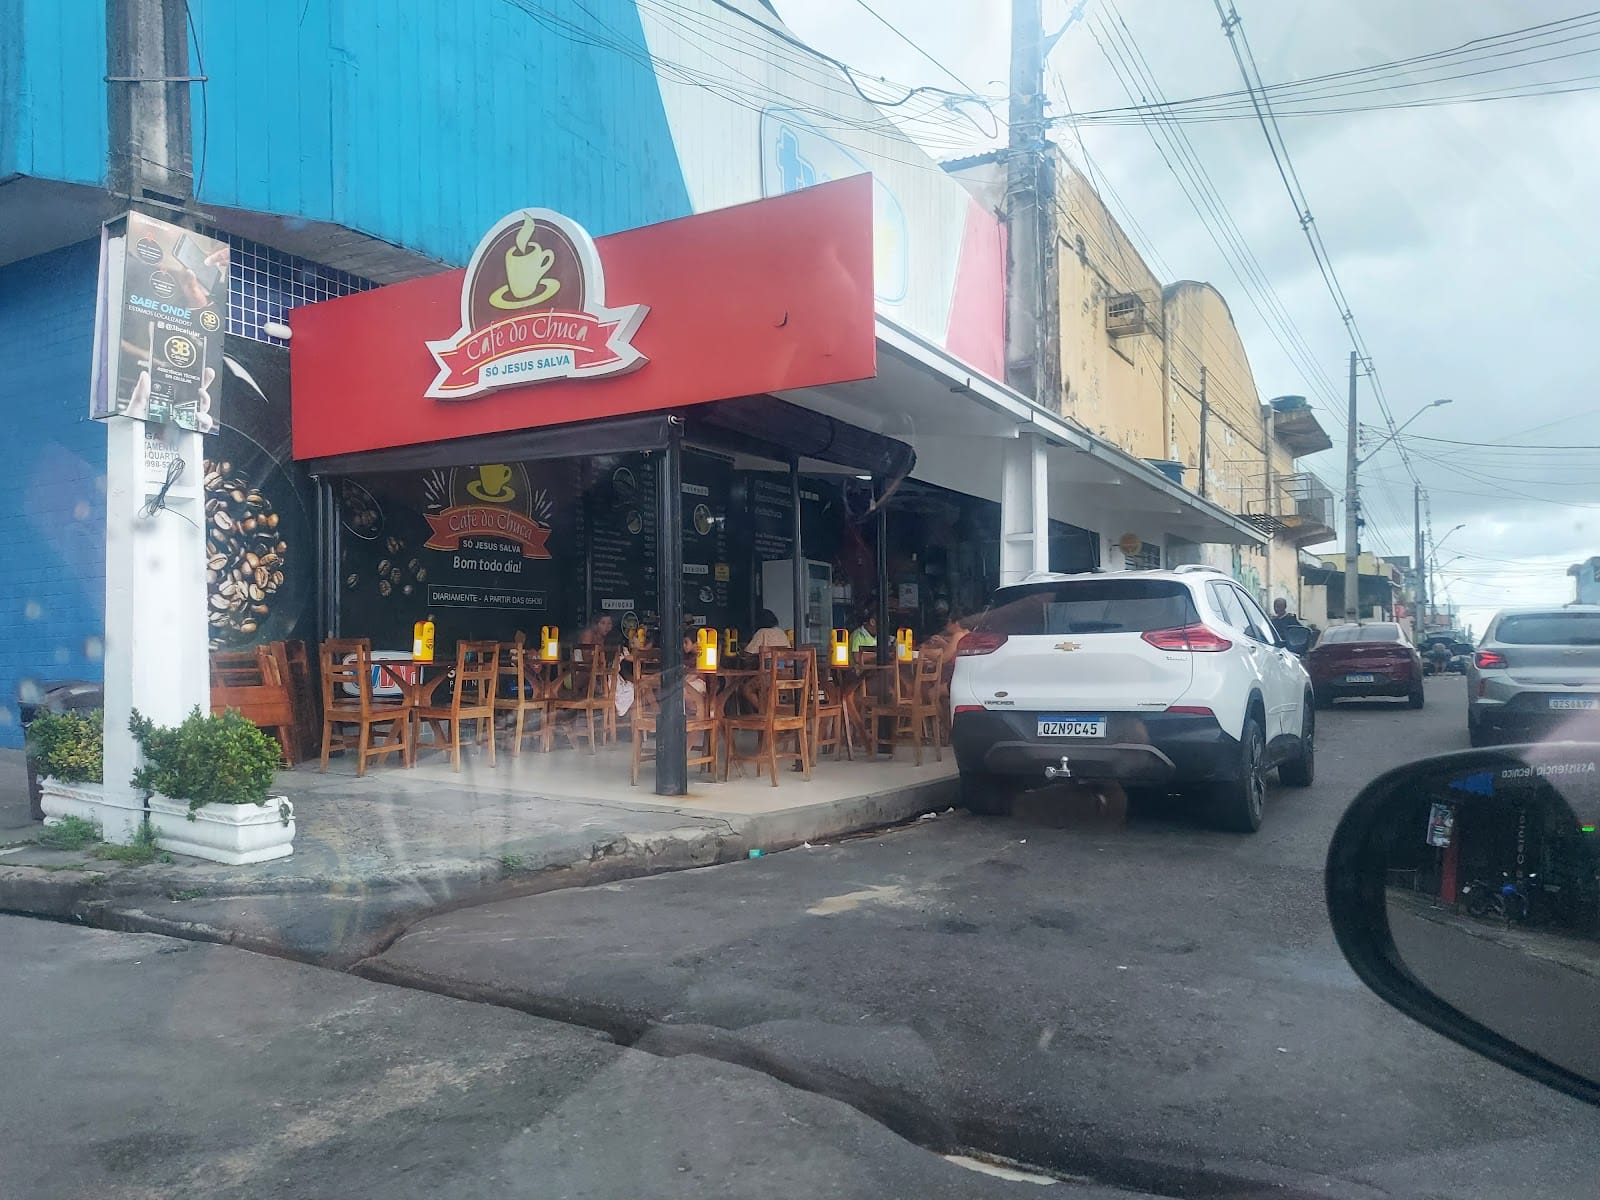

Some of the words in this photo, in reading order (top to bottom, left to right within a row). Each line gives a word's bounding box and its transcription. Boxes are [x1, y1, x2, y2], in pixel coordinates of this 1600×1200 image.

[129, 305, 154, 316] ESTAMOS
[130, 295, 159, 310] SABE
[161, 304, 192, 319] ONDE
[467, 321, 504, 360] Café
[510, 320, 528, 342] do
[532, 308, 588, 342] Chuca
[171, 340, 190, 356] 3B
[486, 362, 499, 377] SÓ
[502, 359, 534, 375] JESUS
[537, 355, 570, 369] SALVA
[149, 452, 180, 460] QUARTO
[481, 510, 494, 528] do
[498, 510, 532, 540] Chuca
[463, 539, 473, 548] SÓ
[475, 542, 498, 550] JESUS
[500, 543, 521, 553] SALVA
[453, 556, 476, 570] Bom
[480, 558, 502, 571] todo
[504, 561, 521, 573] dia!
[433, 593, 478, 602] DIARIAMENTE
[490, 595, 511, 603] PARTIR
[1044, 723, 1097, 735] QZN9C45
